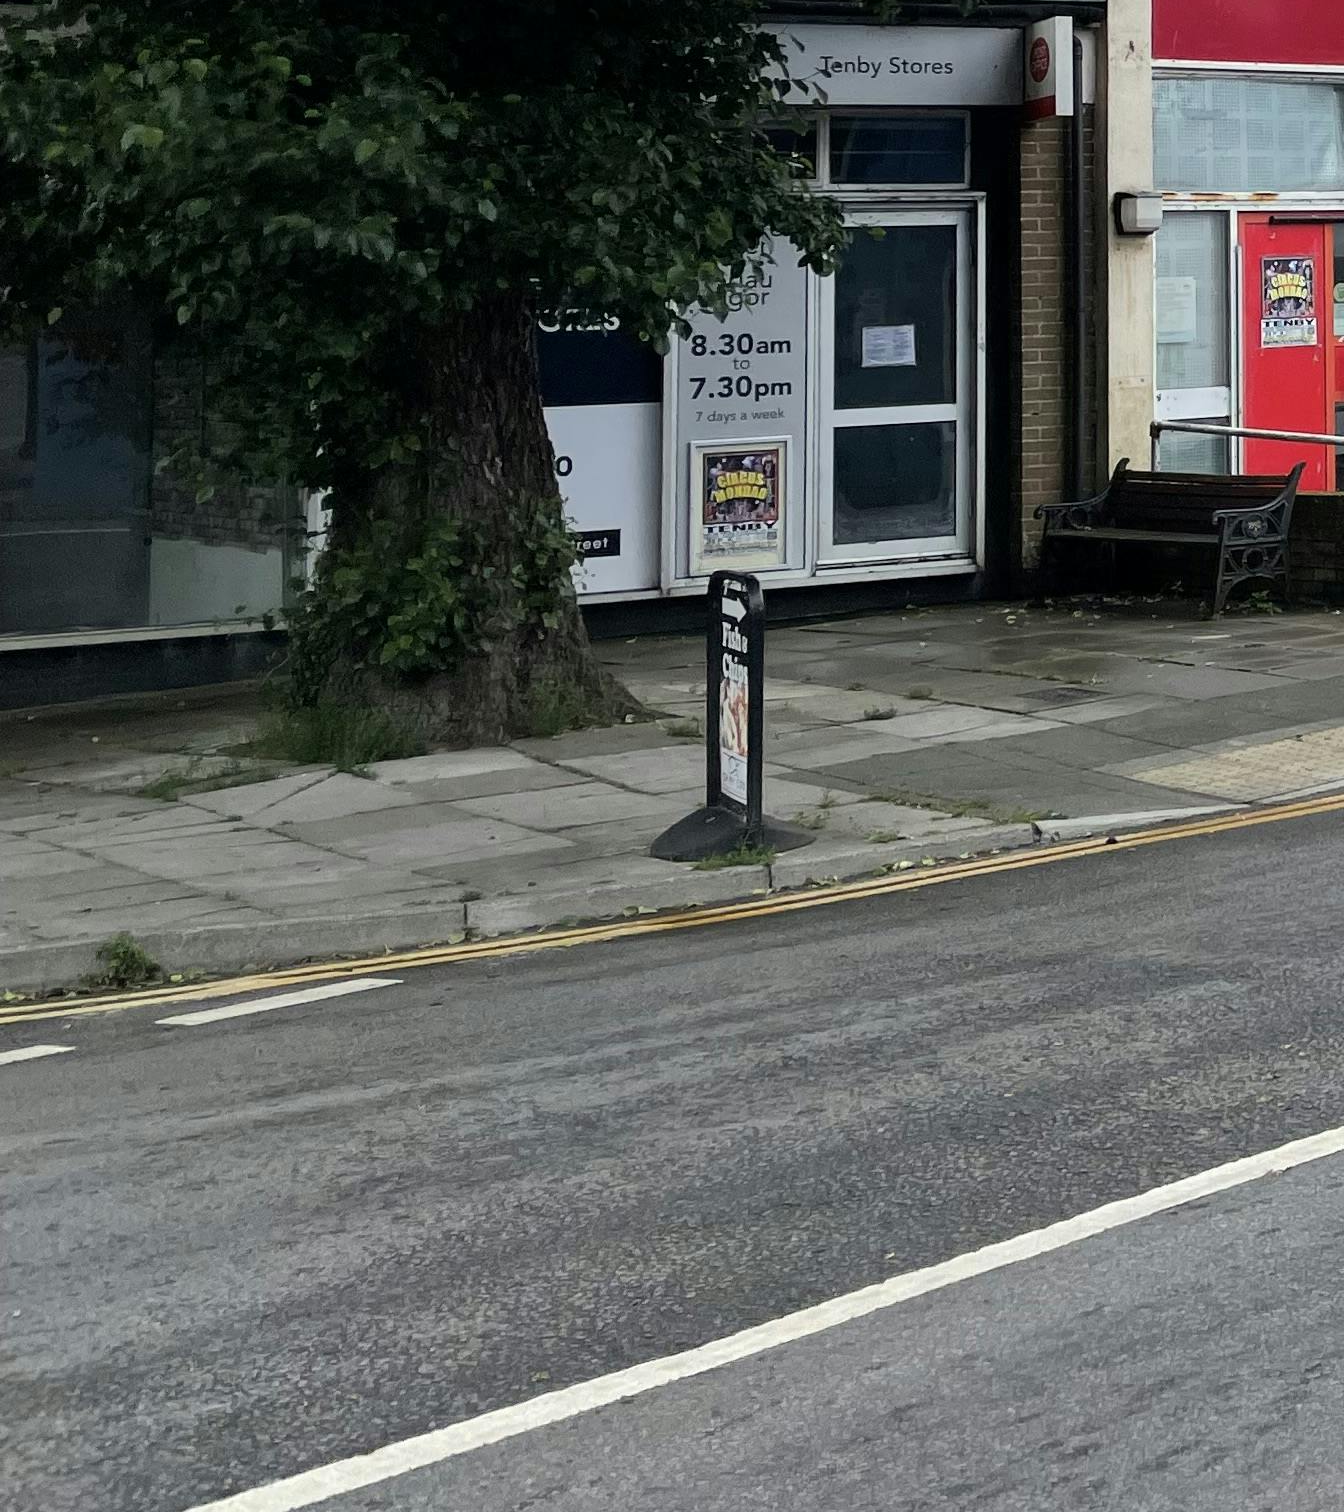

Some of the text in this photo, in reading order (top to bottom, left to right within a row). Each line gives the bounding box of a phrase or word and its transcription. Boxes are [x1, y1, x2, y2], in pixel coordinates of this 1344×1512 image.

[819, 55, 954, 78] Tenby Stores
[1271, 273, 1306, 288] CIRCUS
[1263, 319, 1314, 328] TENBY
[690, 333, 791, 357] 8.30am
[732, 357, 750, 370] to
[689, 375, 792, 402] 7.30pm
[695, 407, 785, 424] 7 days a week
[716, 471, 765, 488] CIRCUS
[721, 621, 742, 652] Fish
[722, 652, 748, 689] Chips
